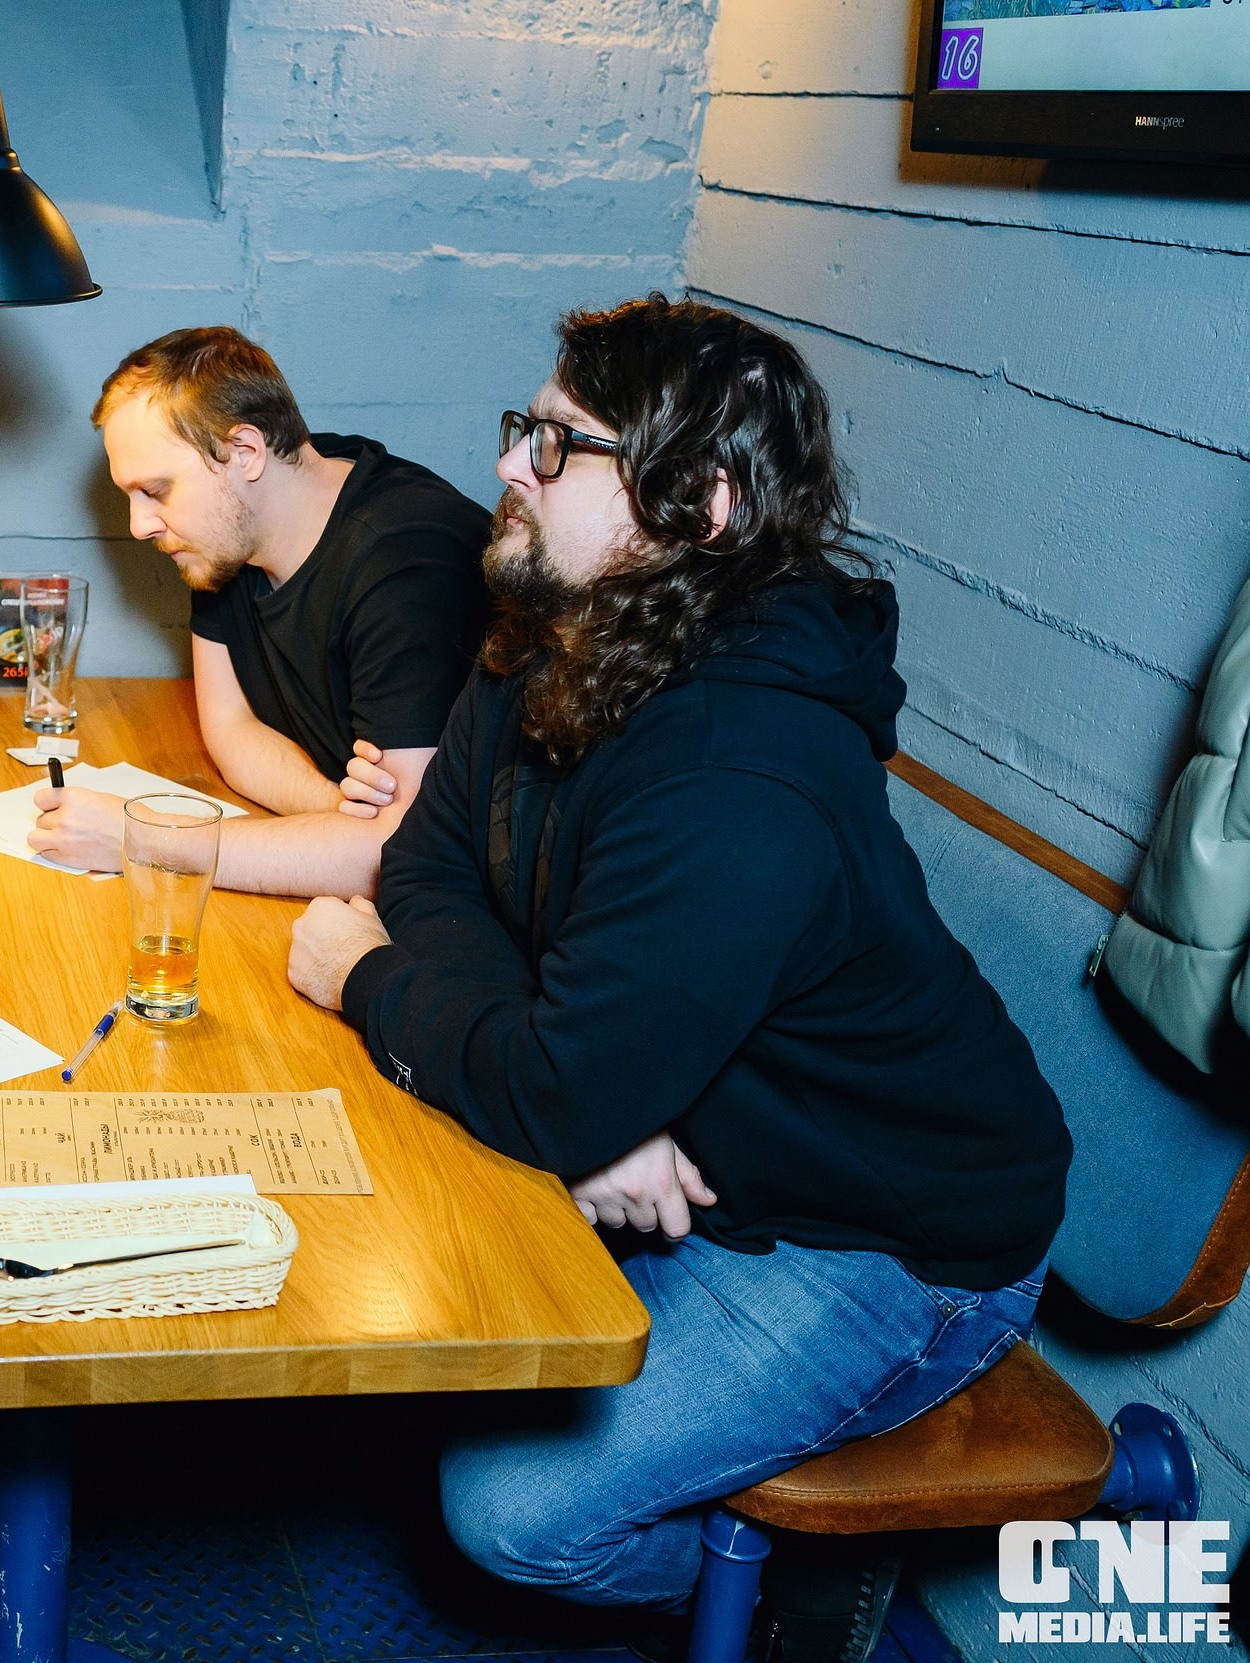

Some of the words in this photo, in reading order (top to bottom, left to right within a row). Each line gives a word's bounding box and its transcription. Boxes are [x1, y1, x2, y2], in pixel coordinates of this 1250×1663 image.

[941, 35, 981, 81] 16
[1135, 115, 1185, 129] HANNspree
[100, 1124, 112, 1154] ЛИМОНАДЫ
[250, 1134, 260, 1146] СОК
[290, 1133, 302, 1148] ВОДА
